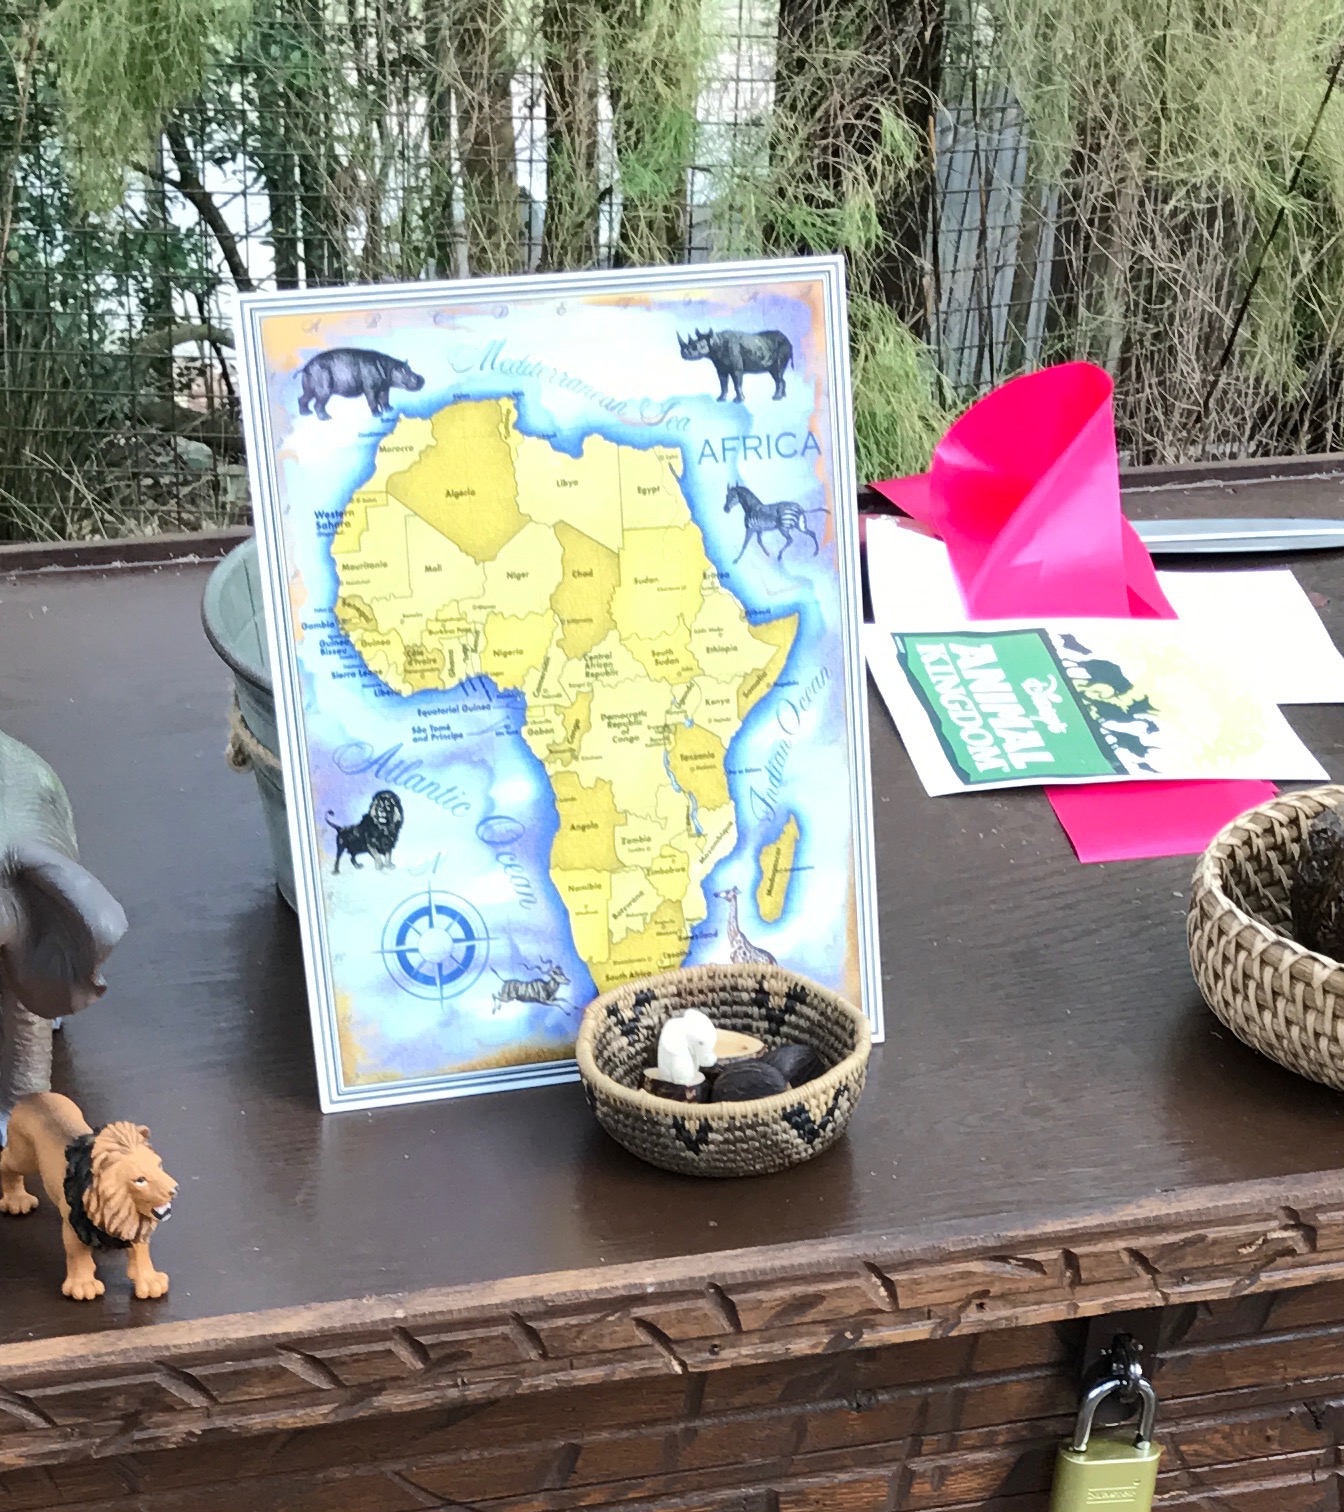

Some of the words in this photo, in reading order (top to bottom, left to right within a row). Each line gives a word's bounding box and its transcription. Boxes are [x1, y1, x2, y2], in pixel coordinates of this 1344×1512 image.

[640, 395, 692, 431] Sea
[378, 444, 414, 453] Morocco
[697, 430, 822, 465] AFRICA
[556, 479, 579, 489] Libya
[445, 488, 476, 499] Algeria
[637, 485, 661, 496] Egypt
[314, 509, 355, 520] Western
[316, 519, 351, 530] Sahara
[342, 561, 388, 571] Mauritania
[424, 564, 443, 573] Mali
[506, 571, 529, 581] Niger
[572, 568, 593, 578] Chad
[634, 576, 658, 585] Sudan
[301, 622, 334, 631] Gambia
[319, 639, 349, 648] Guinea
[361, 639, 391, 648] Guinea
[320, 647, 348, 655] Bissau
[493, 648, 523, 658] Nigeria
[651, 649, 674, 658] South
[706, 645, 738, 655] Ethiopia
[583, 652, 613, 661] Central
[655, 657, 680, 666] Sudan
[584, 660, 614, 670] African
[331, 671, 356, 680] Sierra
[585, 669, 619, 679] Republic
[705, 698, 731, 707] Kenya
[948, 642, 1055, 769] ANIMAL
[417, 705, 460, 717] Equatorial
[462, 703, 491, 713] Guinea
[915, 643, 1011, 773] KINGDOM
[600, 710, 647, 721] Democratic
[607, 720, 643, 730] Republic
[527, 727, 554, 736] Gabon
[412, 734, 428, 743] and
[612, 735, 640, 744] Congo
[750, 739, 793, 822] Indian
[776, 666, 833, 735] Ocean
[680, 751, 715, 762] Tanzania
[332, 741, 471, 817] Atlantic
[476, 815, 537, 910] Ocean
[570, 821, 599, 832] Angola
[621, 835, 651, 845] Zambia
[646, 865, 686, 876] Zimbabwe
[568, 882, 602, 892] Namibia
[605, 972, 628, 982] South
[628, 970, 652, 980] Africa
